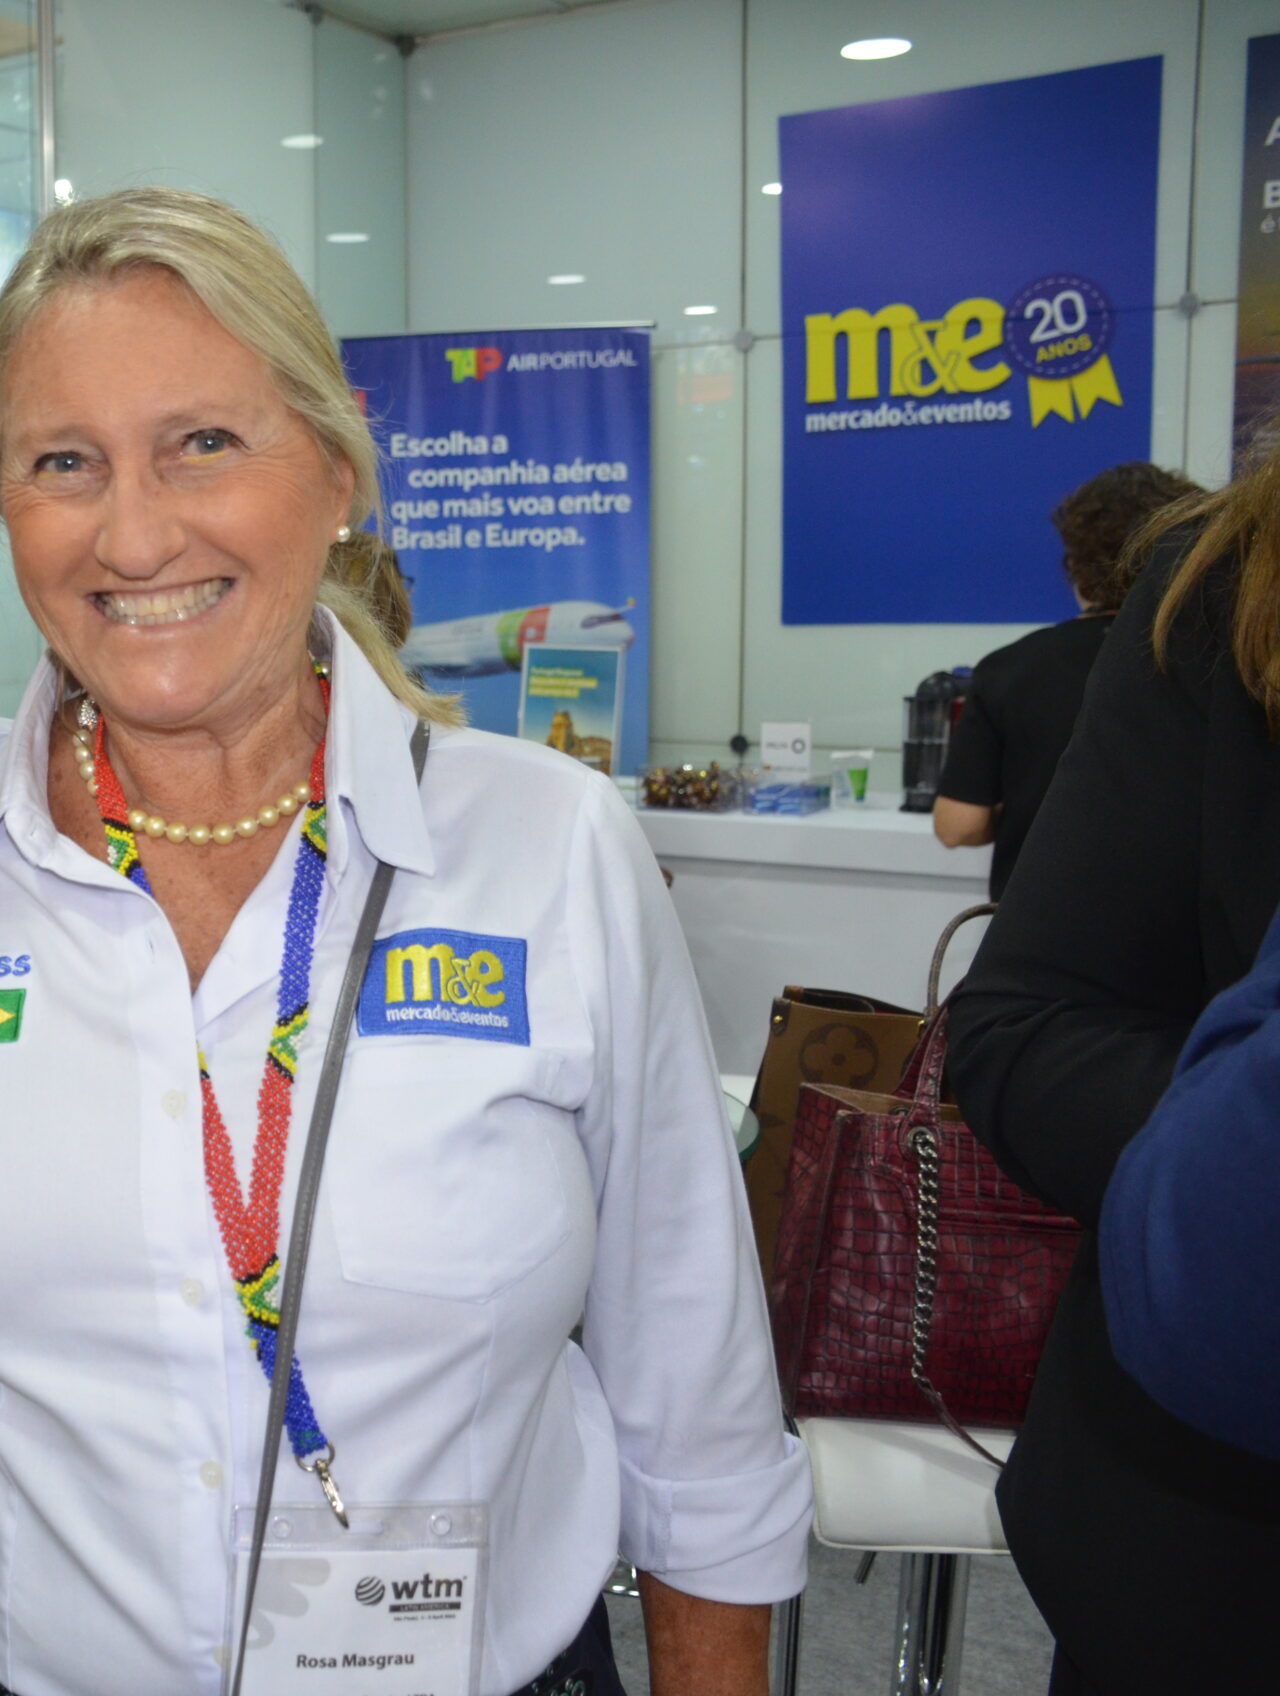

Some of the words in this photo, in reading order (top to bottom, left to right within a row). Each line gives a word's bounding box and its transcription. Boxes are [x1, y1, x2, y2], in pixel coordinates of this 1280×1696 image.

[1024, 289, 1087, 344] 20
[445, 347, 503, 383] TAP
[805, 297, 1012, 403] m&e
[1036, 333, 1093, 364] ANOS
[805, 398, 1012, 432] mercado&eventos
[390, 432, 489, 458] Escolha
[491, 434, 509, 454] a
[408, 459, 550, 492] companhia
[553, 458, 628, 484] aérea
[391, 500, 439, 524] que
[442, 493, 504, 517] mais
[506, 495, 555, 515] voa
[558, 490, 632, 514] entre
[392, 524, 462, 550] Brasil
[464, 529, 482, 547] e
[485, 524, 586, 552] Europa.
[385, 944, 506, 1008] m&e
[391, 1573, 463, 1600] wtm
[296, 1655, 338, 1669] Rosa
[342, 1653, 415, 1670] Masgrau
